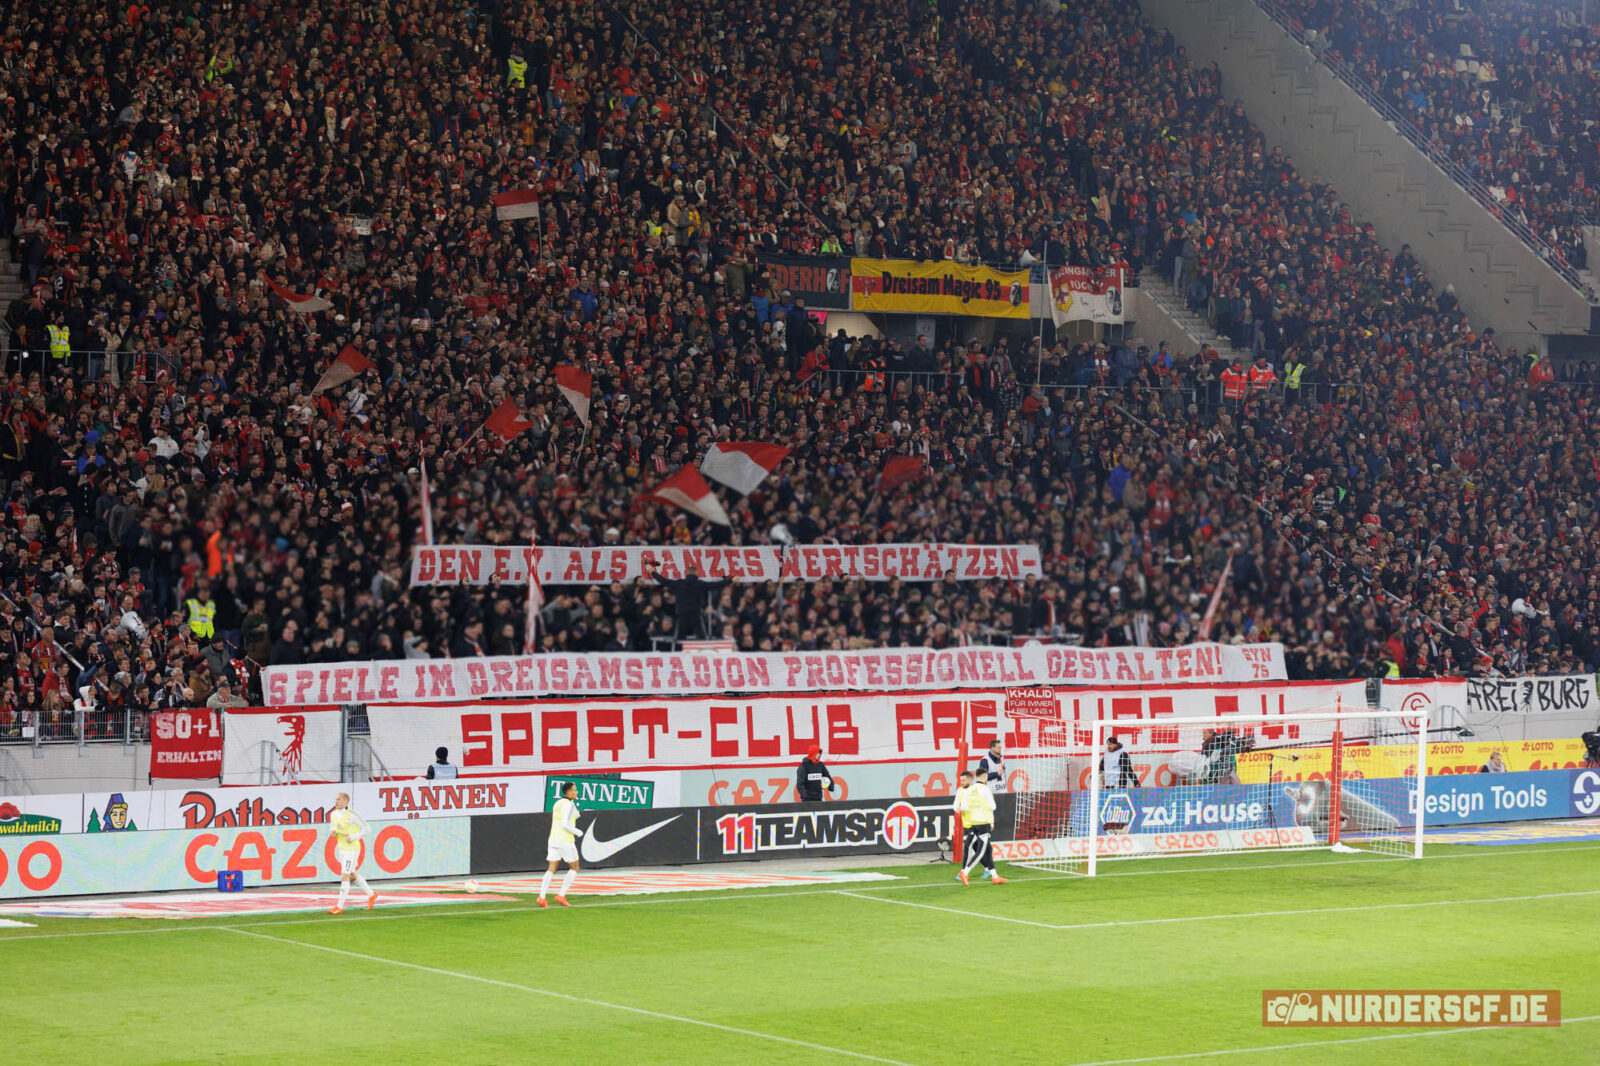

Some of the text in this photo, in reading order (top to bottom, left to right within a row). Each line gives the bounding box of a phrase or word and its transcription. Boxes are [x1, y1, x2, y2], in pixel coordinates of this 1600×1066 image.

[882, 271, 1001, 304] Dreisam Magic 95
[418, 549, 481, 581] DEN
[563, 550, 628, 580] ALS
[640, 548, 766, 580] GANZES
[773, 543, 1037, 578] WERTSCHÄTZEN-
[268, 645, 1223, 706] SPIELE IM DREISAMSTADION PROFESSIONELL GESTALTEN!
[1252, 663, 1269, 678] 75
[1008, 688, 1052, 699] KHALID
[1537, 678, 1590, 711] BURG
[1010, 699, 1053, 707] FÜR IMMER
[461, 704, 859, 767] SPORT-CLUB
[1347, 748, 1371, 757] LOTTO
[1440, 745, 1464, 754] LOTTO
[1531, 742, 1554, 751] LOTTO
[157, 750, 222, 763] ERHALTEN
[1248, 752, 1273, 762] LOTTO
[379, 783, 508, 813] TANNEN
[550, 779, 649, 805] TNNEN
[1491, 784, 1548, 810] Tools
[1184, 800, 1264, 825] Hause
[1154, 833, 1219, 849] CAZOO
[1242, 830, 1304, 846] CAZOO
[992, 842, 1045, 858] AZOO
